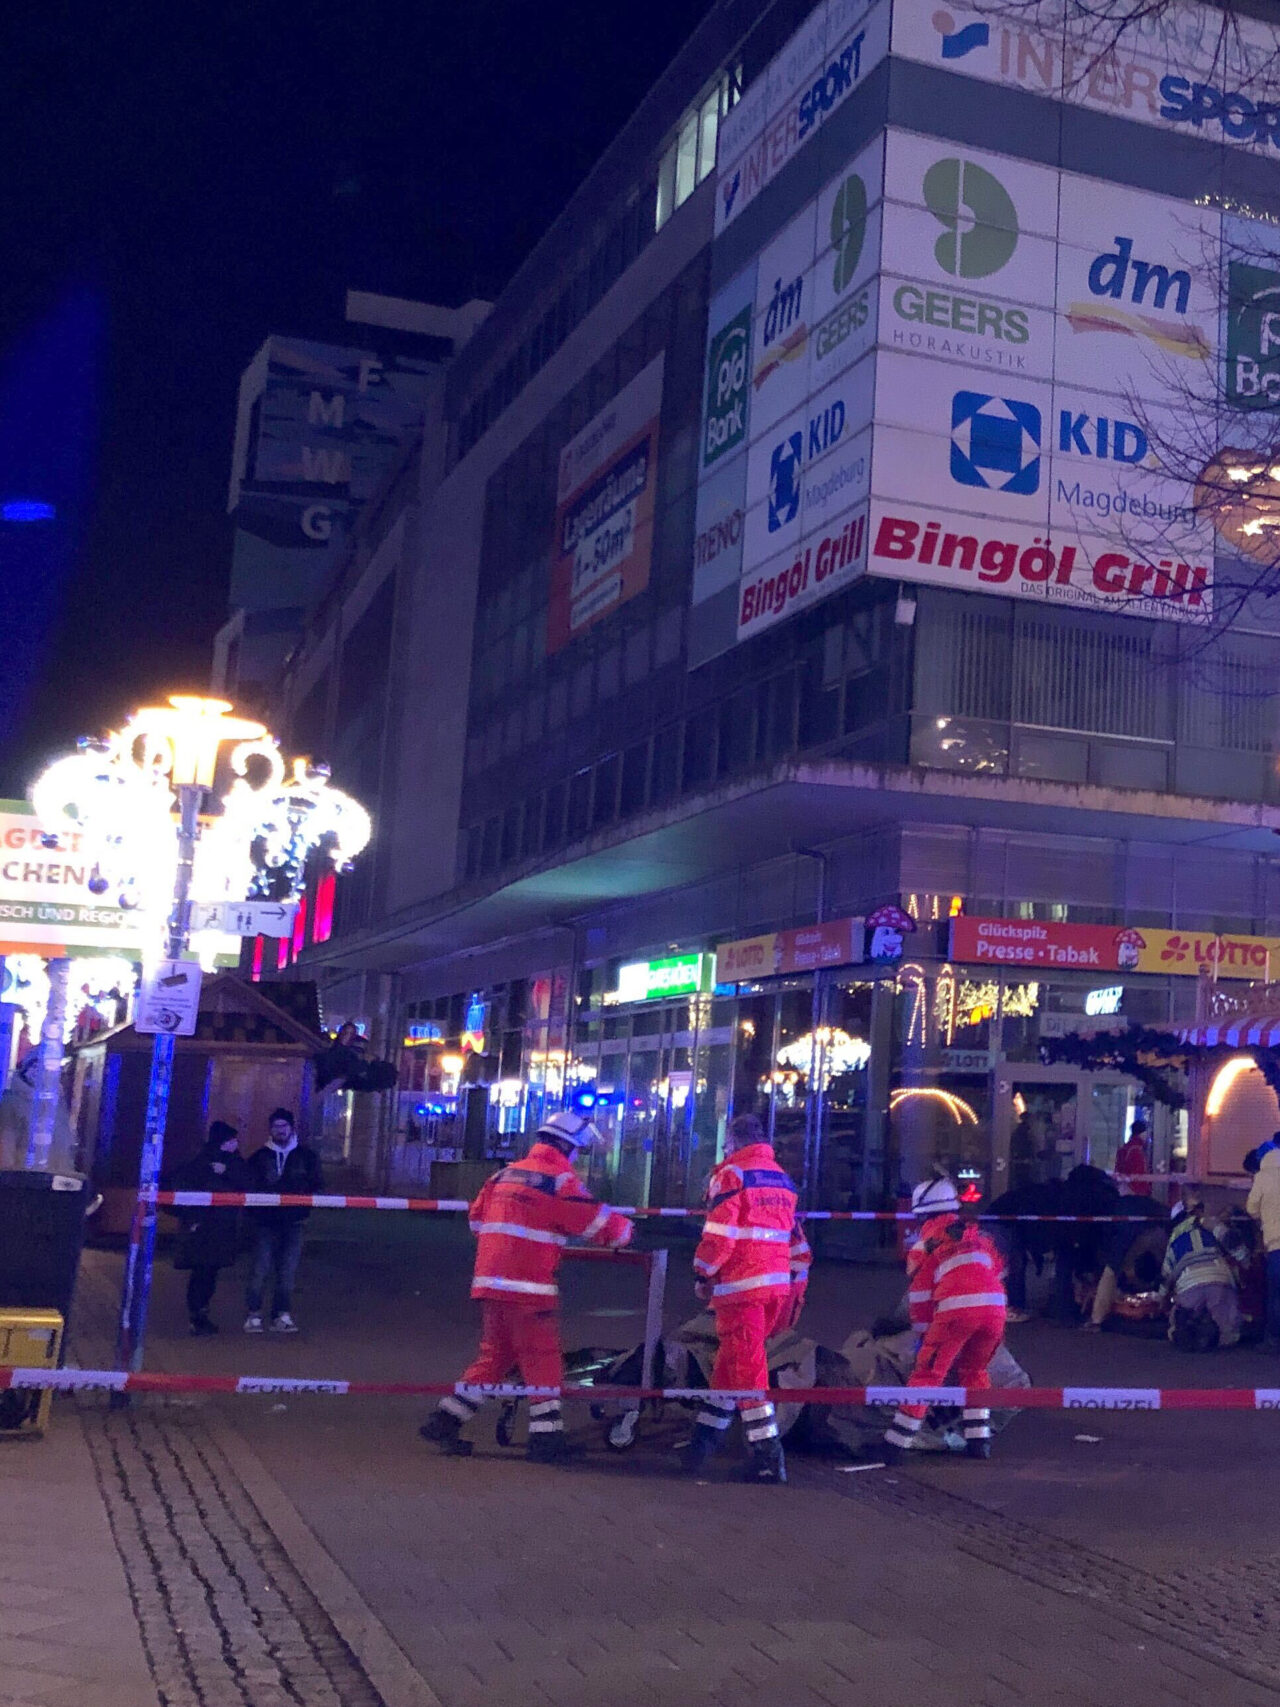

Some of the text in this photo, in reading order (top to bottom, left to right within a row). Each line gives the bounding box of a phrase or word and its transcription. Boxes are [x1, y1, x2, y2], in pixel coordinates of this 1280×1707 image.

[1088, 236, 1192, 314] dm
[763, 276, 803, 347] dm
[815, 291, 869, 361] GEERS
[892, 285, 1031, 344] GEERS
[893, 329, 1026, 369] HÖRAKUSTIK
[706, 398, 743, 454] Bank
[808, 400, 845, 460] KID
[1059, 410, 1149, 464] KID
[1057, 479, 1196, 531] Magdeburg
[740, 547, 811, 627] Bingöl
[814, 514, 866, 583] Grill
[873, 516, 1208, 606] Bingöl Grill
[1020, 581, 1043, 596] DAS
[976, 941, 1099, 964] Presse Tabak
[978, 923, 1048, 941] Glückspilz
[1194, 940, 1268, 967] LOTTO
